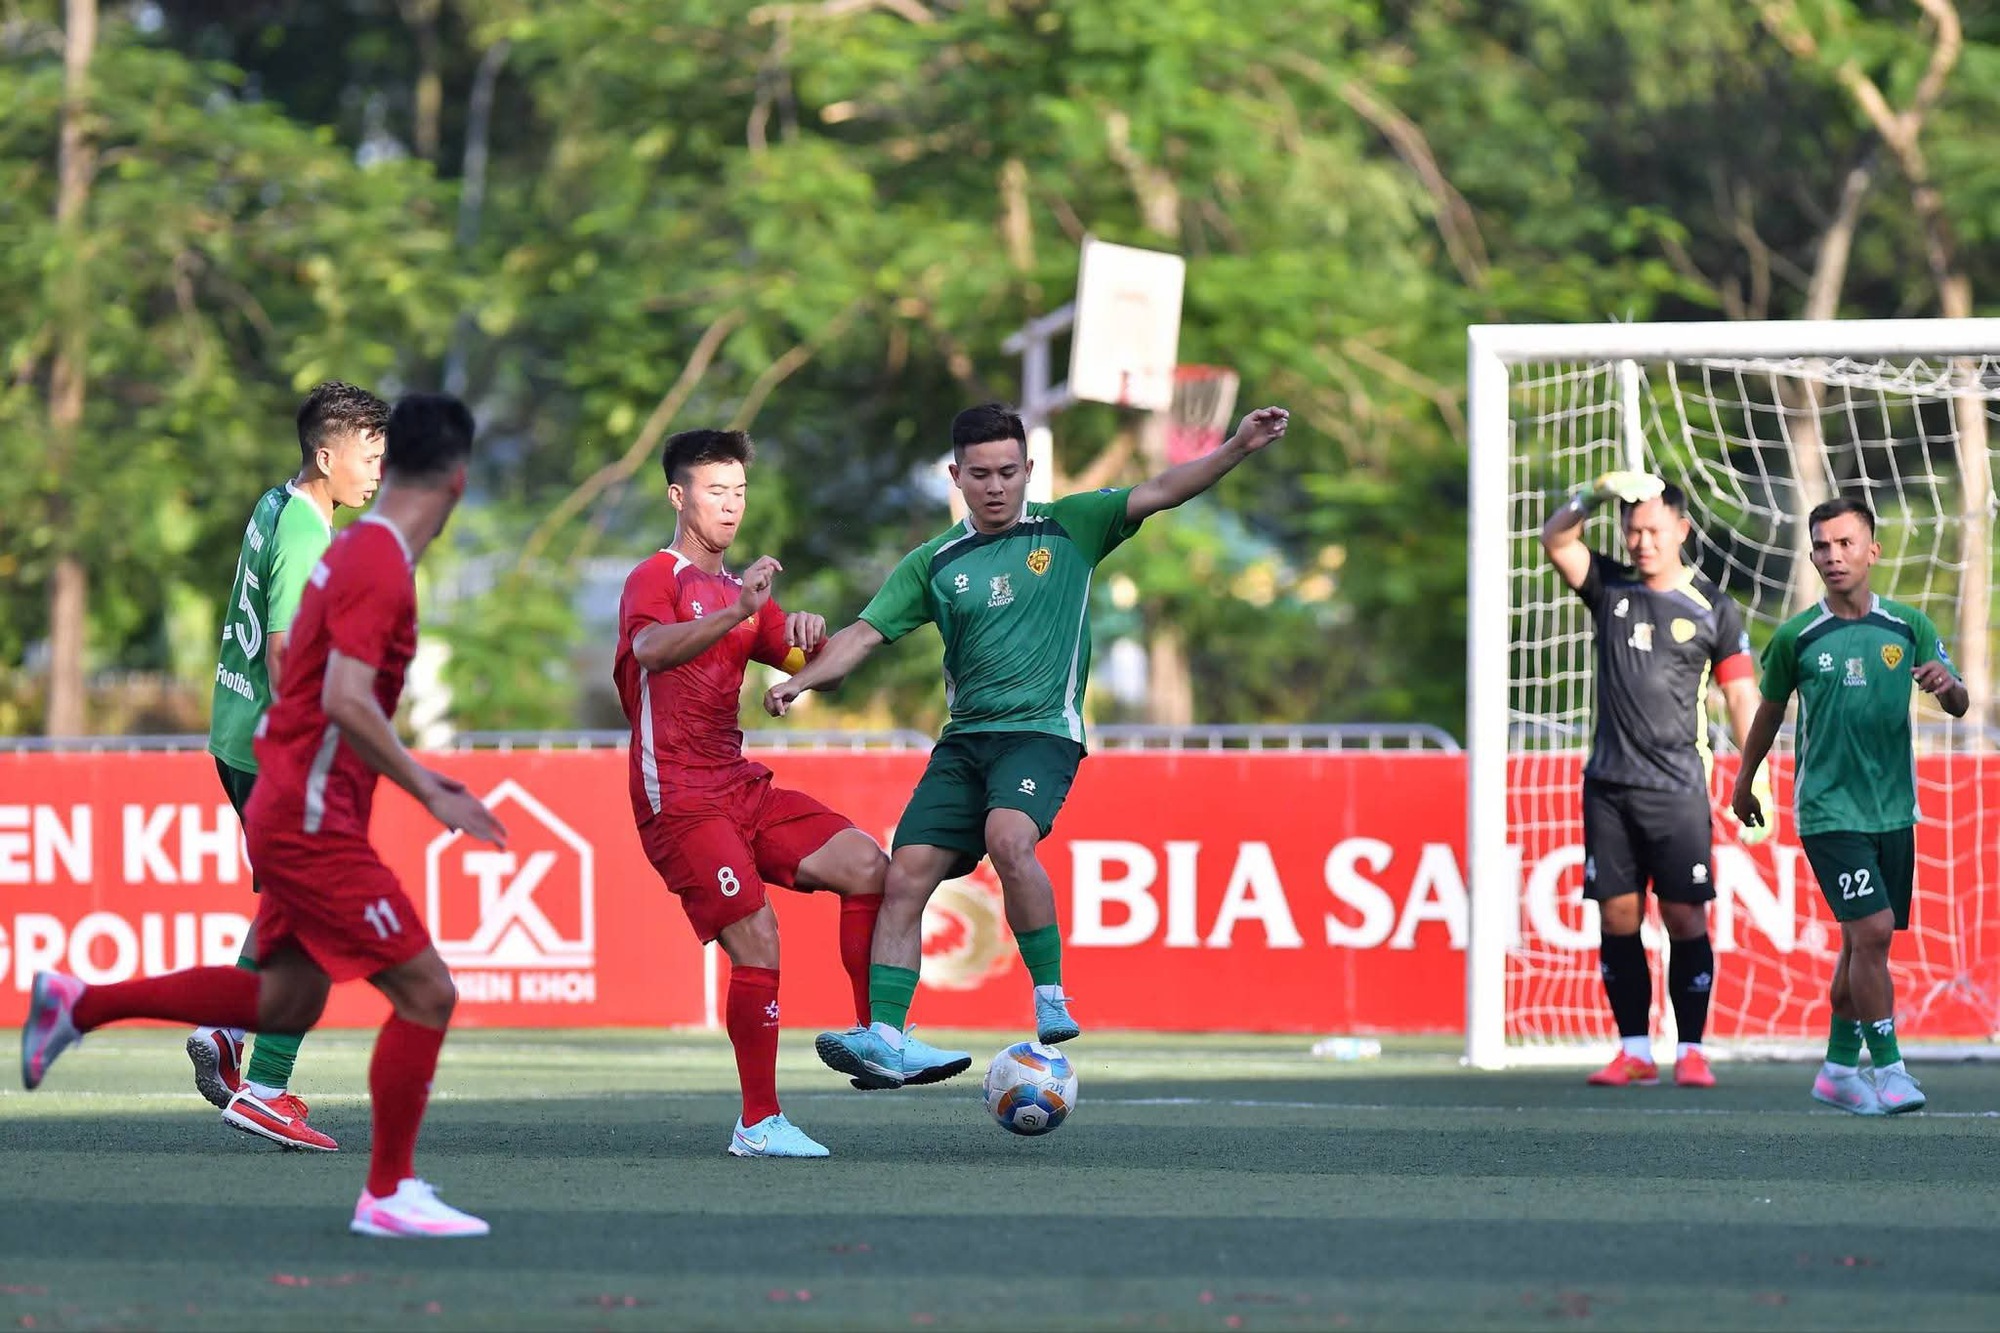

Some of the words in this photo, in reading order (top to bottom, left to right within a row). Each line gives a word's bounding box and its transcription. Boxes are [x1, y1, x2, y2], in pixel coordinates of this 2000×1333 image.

[987, 596, 1015, 608] SAIGON
[122, 804, 253, 883] KH
[717, 866, 741, 898] 8
[1068, 839, 1305, 949] BIA
[1324, 837, 1799, 952] SAGN
[1838, 868, 1875, 901] 22
[364, 898, 402, 940] 11
